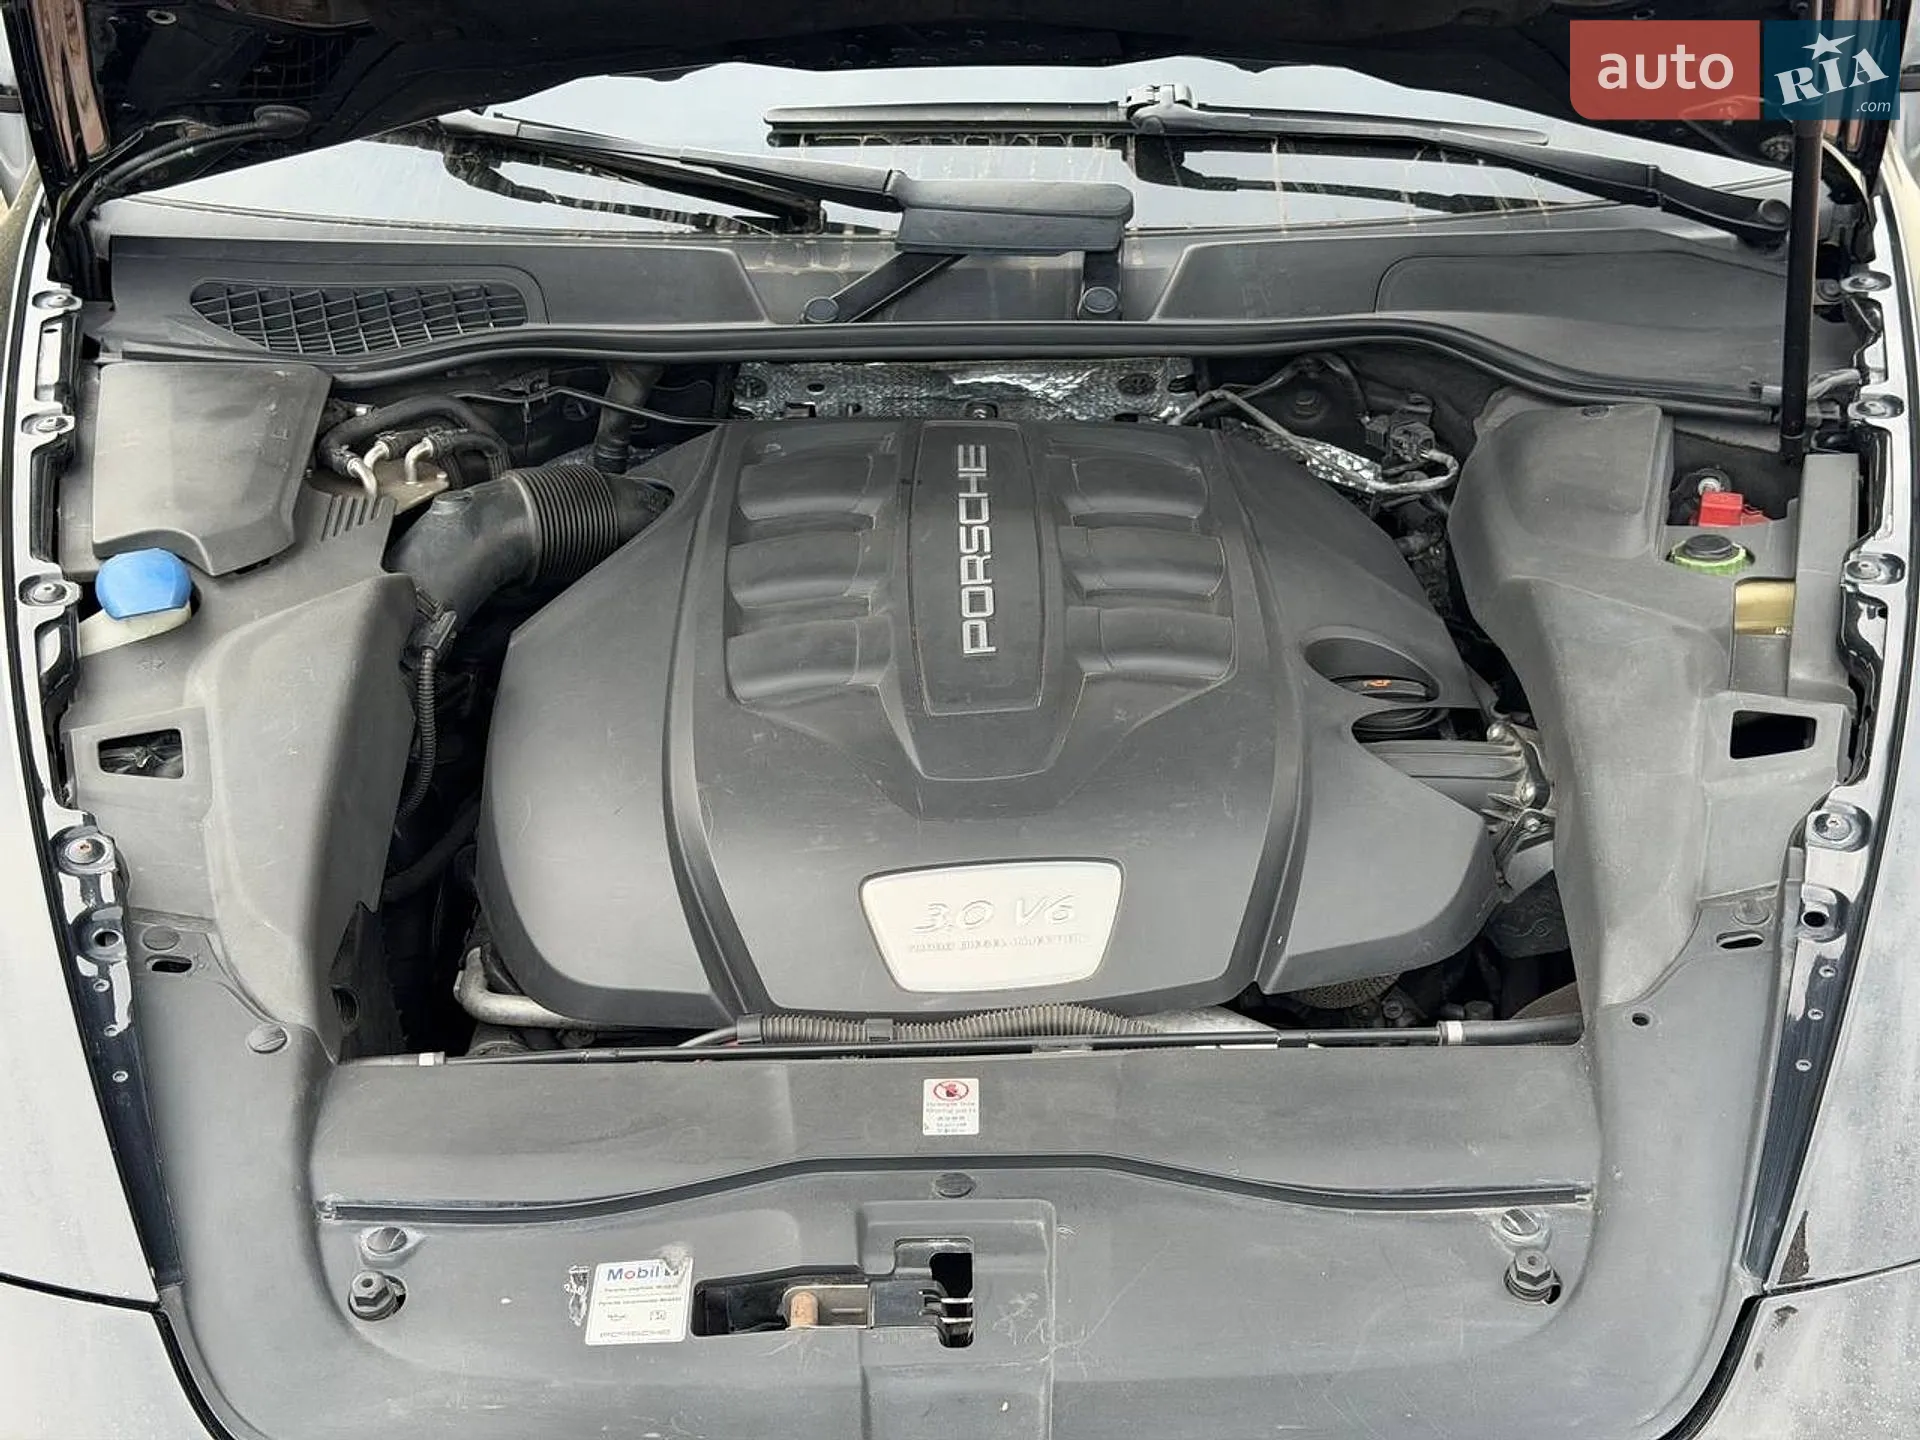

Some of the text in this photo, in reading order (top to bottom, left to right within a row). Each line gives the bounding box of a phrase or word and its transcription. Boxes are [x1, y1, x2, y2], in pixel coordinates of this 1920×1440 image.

[957, 444, 997, 655] PORSCHE
[1014, 893, 1077, 928] V6
[607, 1264, 660, 1281] Mobil
